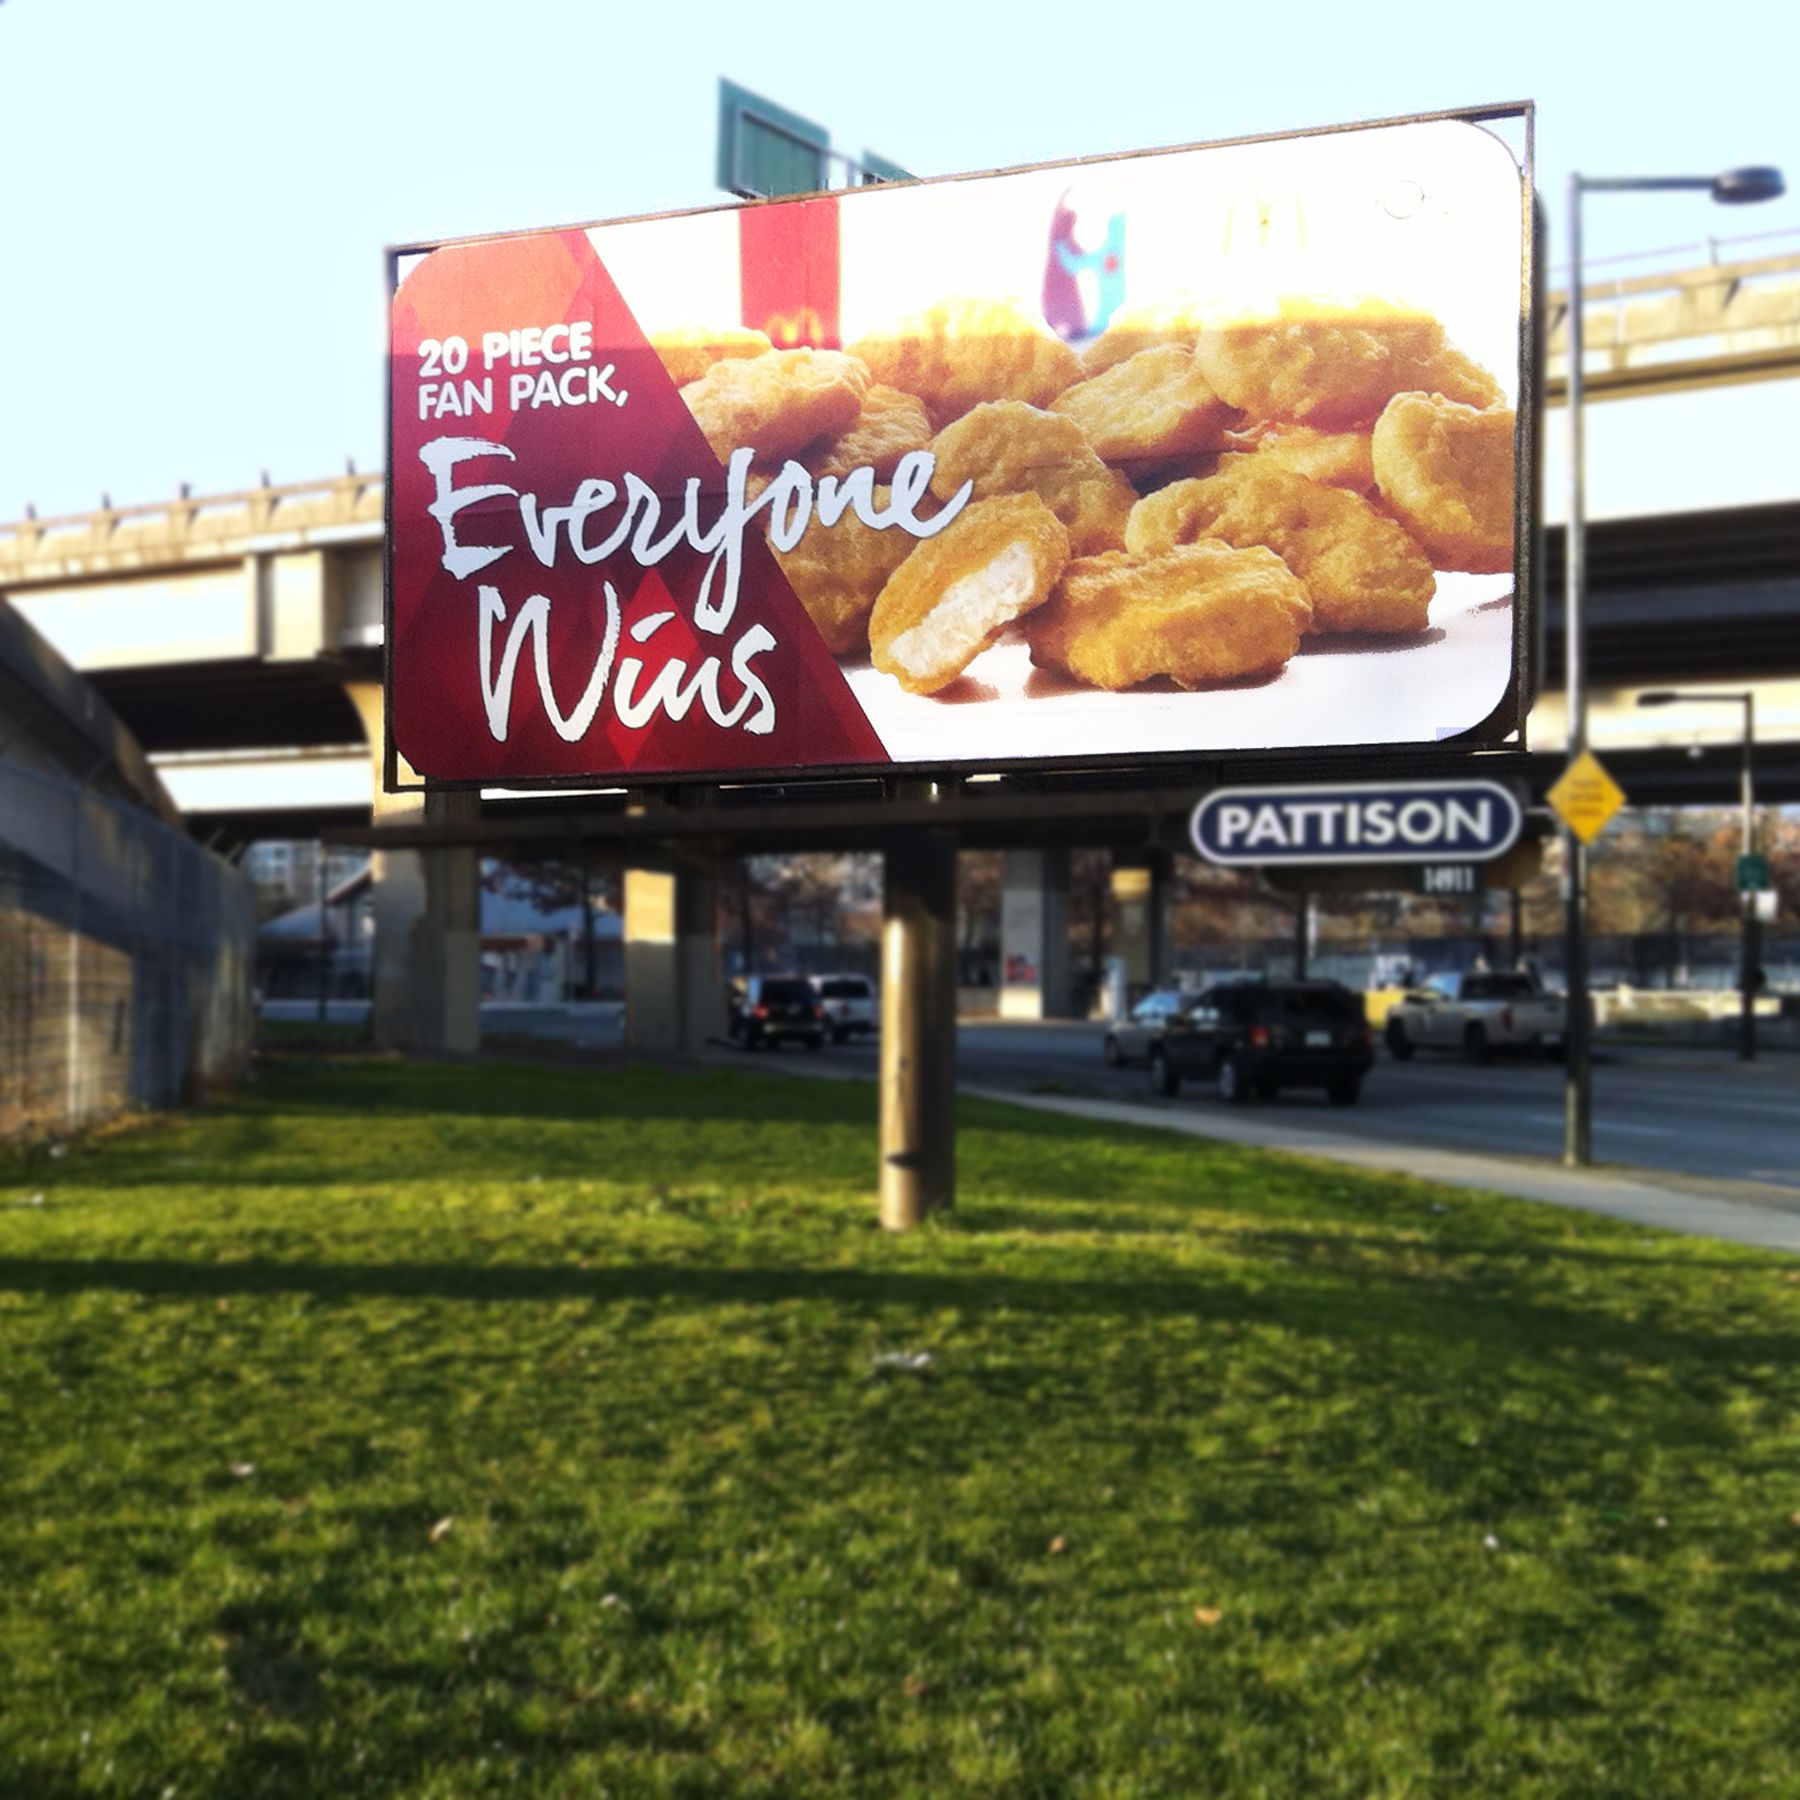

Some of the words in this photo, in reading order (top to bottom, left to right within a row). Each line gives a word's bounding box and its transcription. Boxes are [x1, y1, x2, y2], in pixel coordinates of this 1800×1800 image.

[418, 336, 469, 378] 20
[482, 321, 593, 370] PIECE
[418, 378, 494, 421] FAN
[508, 364, 629, 412] PACK,
[418, 436, 974, 635] Everyone
[477, 580, 778, 743] Wins
[1216, 800, 1493, 847] PATTISON
